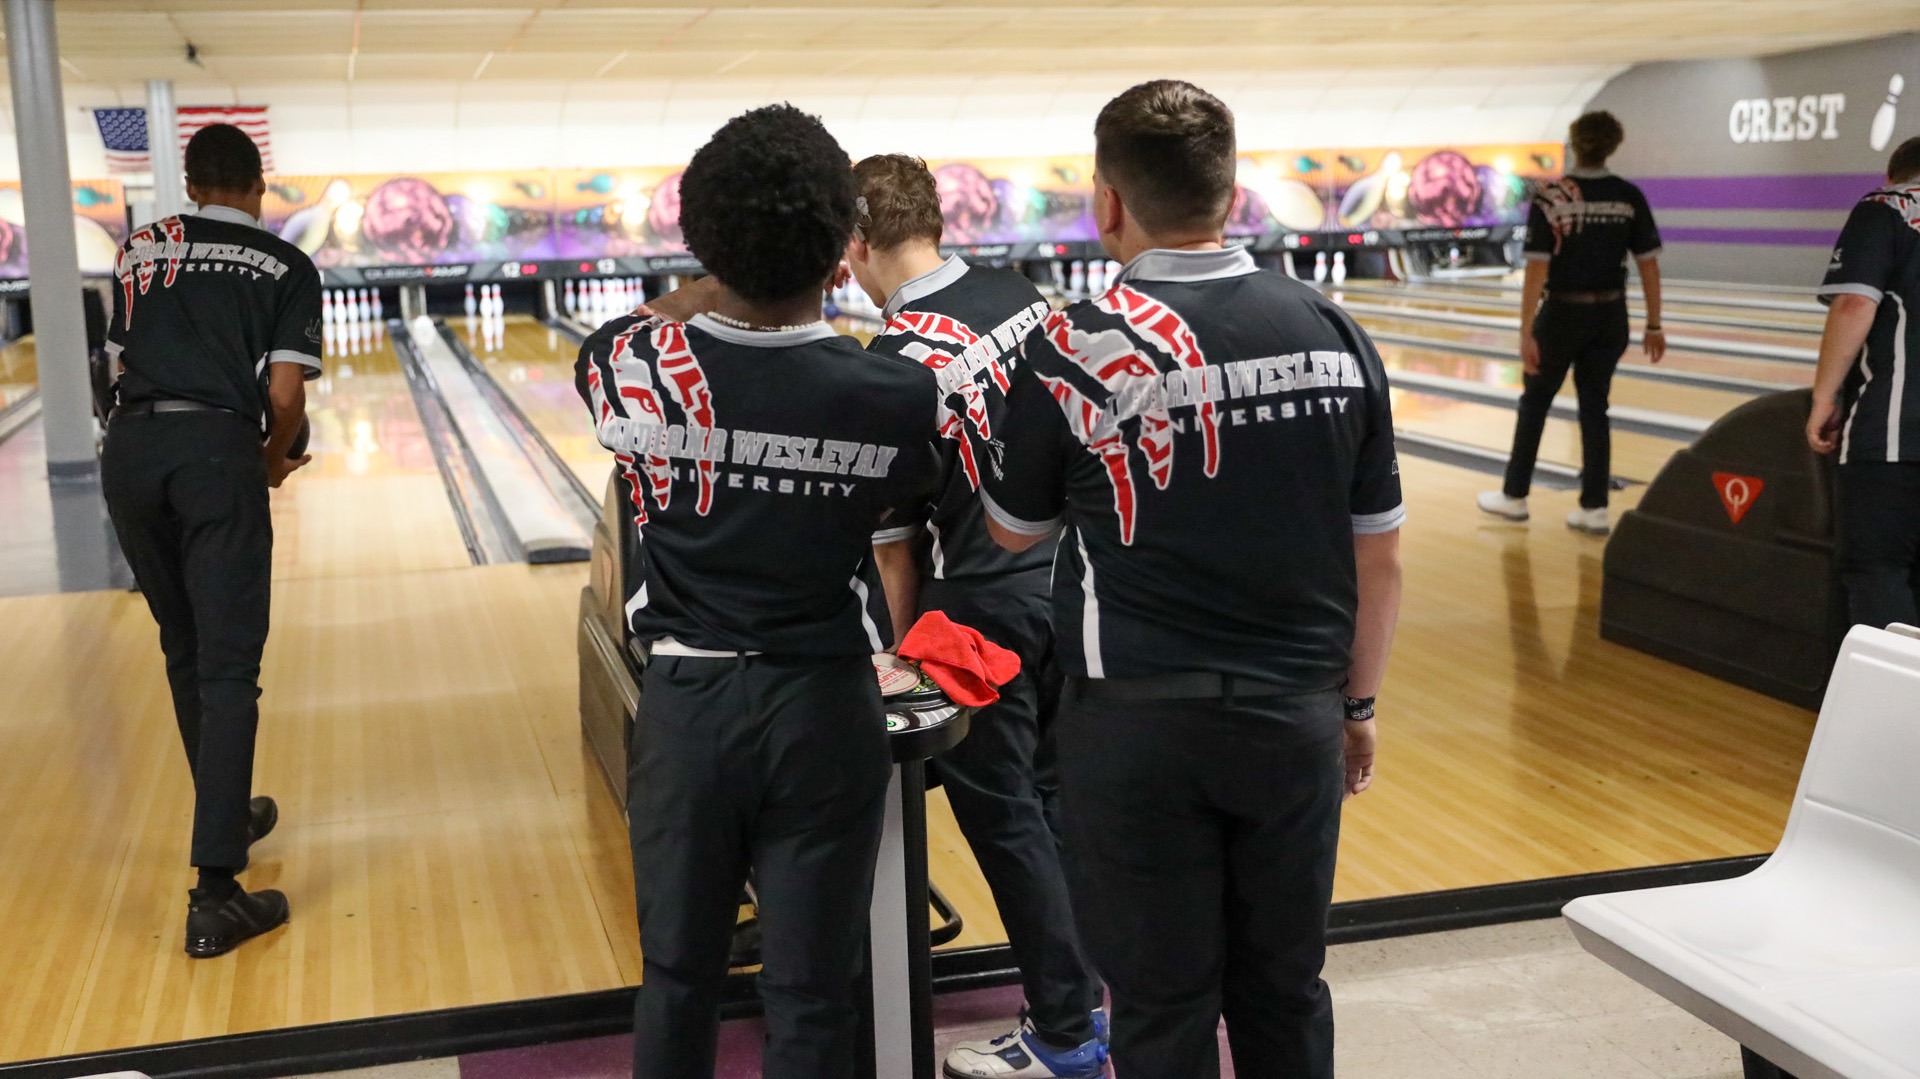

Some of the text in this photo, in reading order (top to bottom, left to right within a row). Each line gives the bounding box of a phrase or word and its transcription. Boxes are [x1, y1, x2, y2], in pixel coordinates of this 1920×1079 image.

[1729, 93, 1846, 144] CREST
[502, 261, 520, 278] 12
[597, 258, 616, 275] 13
[990, 301, 1050, 353] WESLE
[1094, 370, 1224, 438] IANA
[1147, 396, 1350, 434] NIVERSITY
[732, 429, 898, 479] WESLEYAN
[642, 463, 856, 498] NIVERSITY
